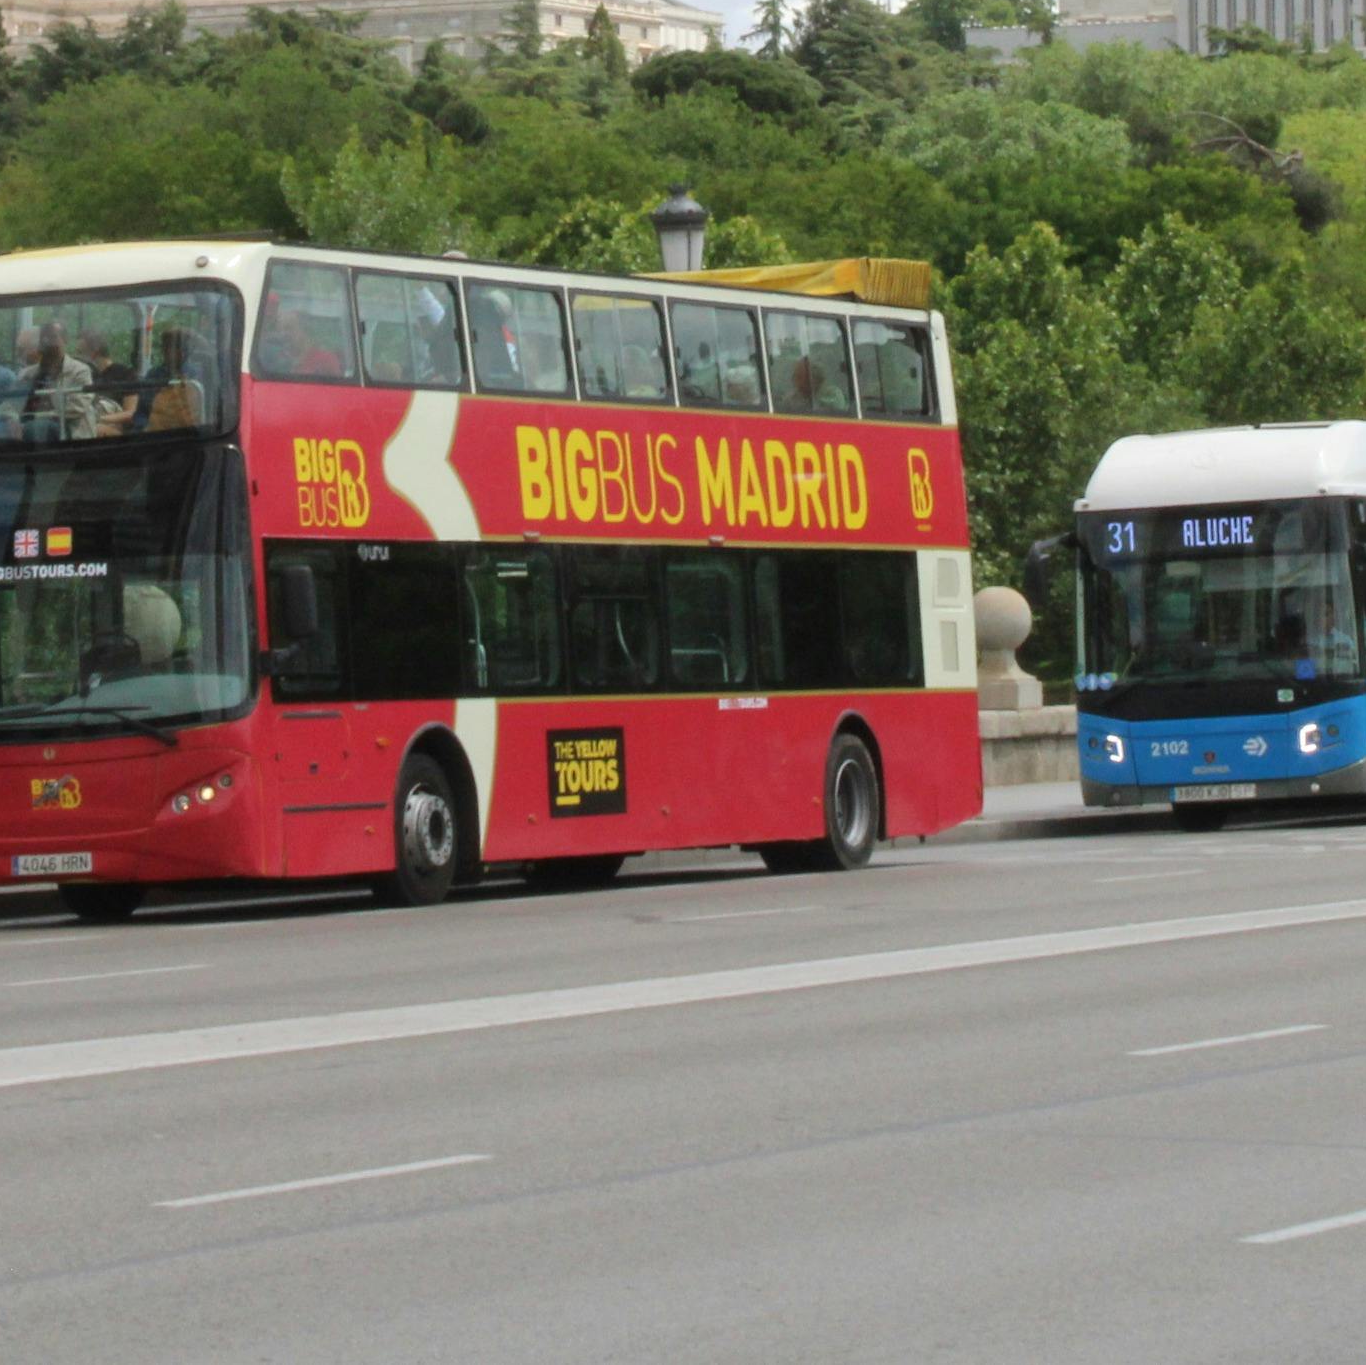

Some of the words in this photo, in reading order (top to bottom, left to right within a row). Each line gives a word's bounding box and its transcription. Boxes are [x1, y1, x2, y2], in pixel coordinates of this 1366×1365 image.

[293, 438, 335, 483] BIG
[695, 436, 869, 530] MADRID
[298, 486, 340, 527] BUS
[1107, 522, 1135, 553] 31
[1182, 516, 1254, 547] ALUCHE
[554, 741, 574, 759] THE
[575, 738, 617, 758] YELLOW
[1151, 740, 1189, 757] 2102
[555, 759, 619, 793] TOURS
[22, 858, 57, 872] 4046
[61, 856, 89, 870] HRN
